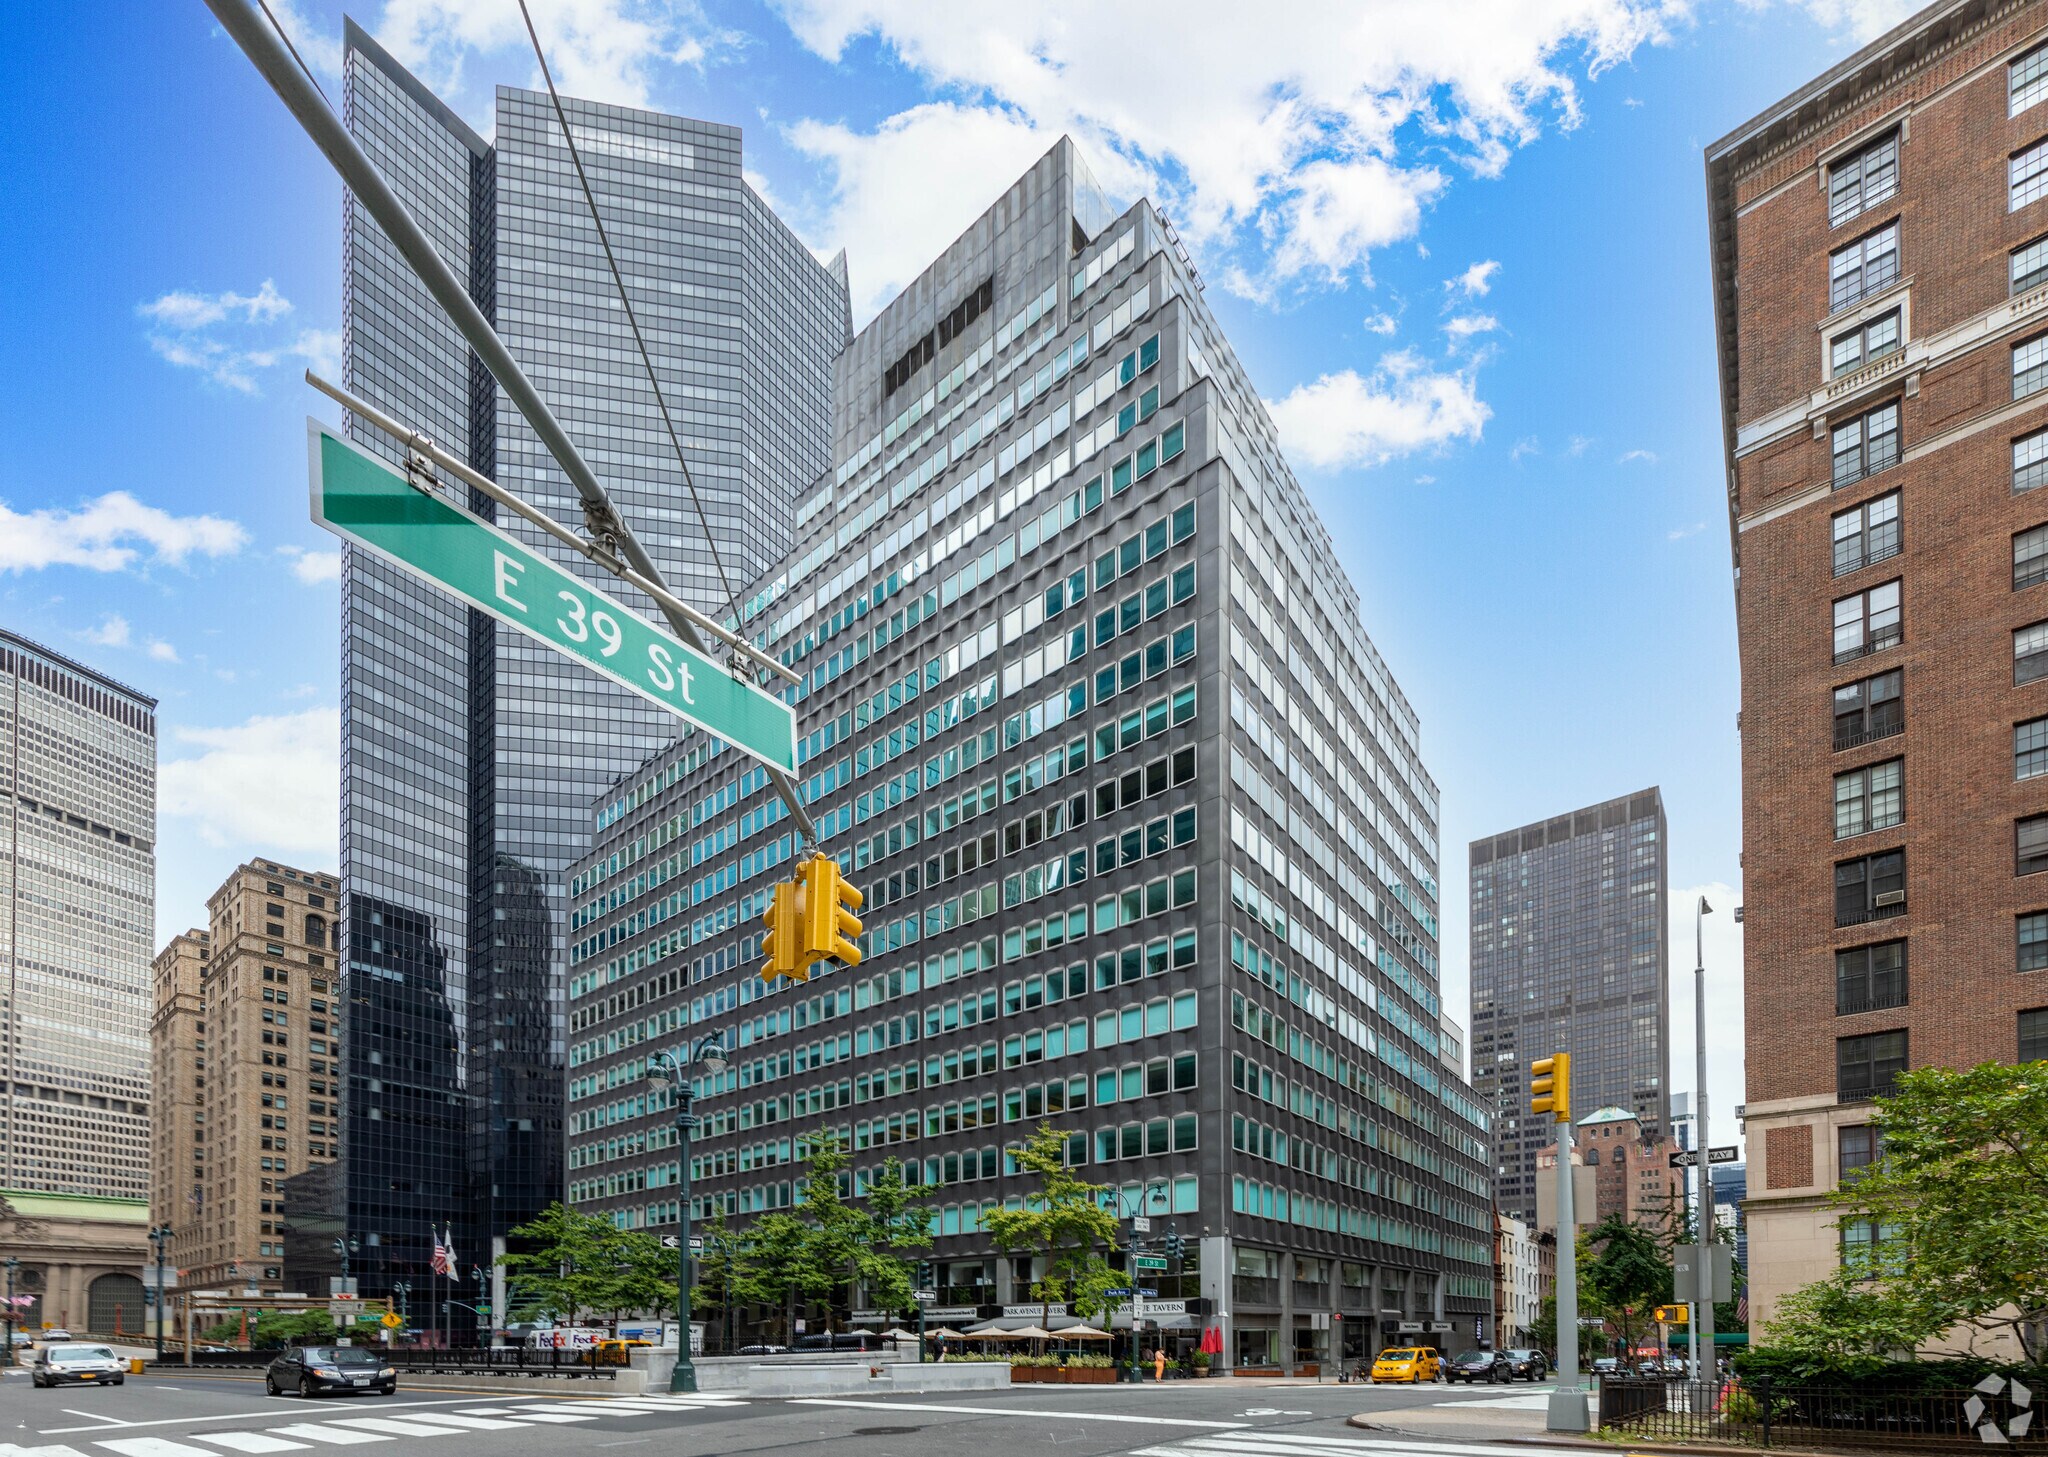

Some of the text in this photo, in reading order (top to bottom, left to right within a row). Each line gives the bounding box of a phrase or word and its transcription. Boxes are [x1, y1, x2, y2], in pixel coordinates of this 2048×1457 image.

[494, 549, 695, 705] E 39 St
[1679, 1154, 1697, 1162] ONE
[1019, 1307, 1041, 1315] AVENUE
[1047, 1306, 1066, 1314] AVERN
[1153, 1303, 1183, 1312] TAVERN
[539, 1332, 566, 1347] FedEx
